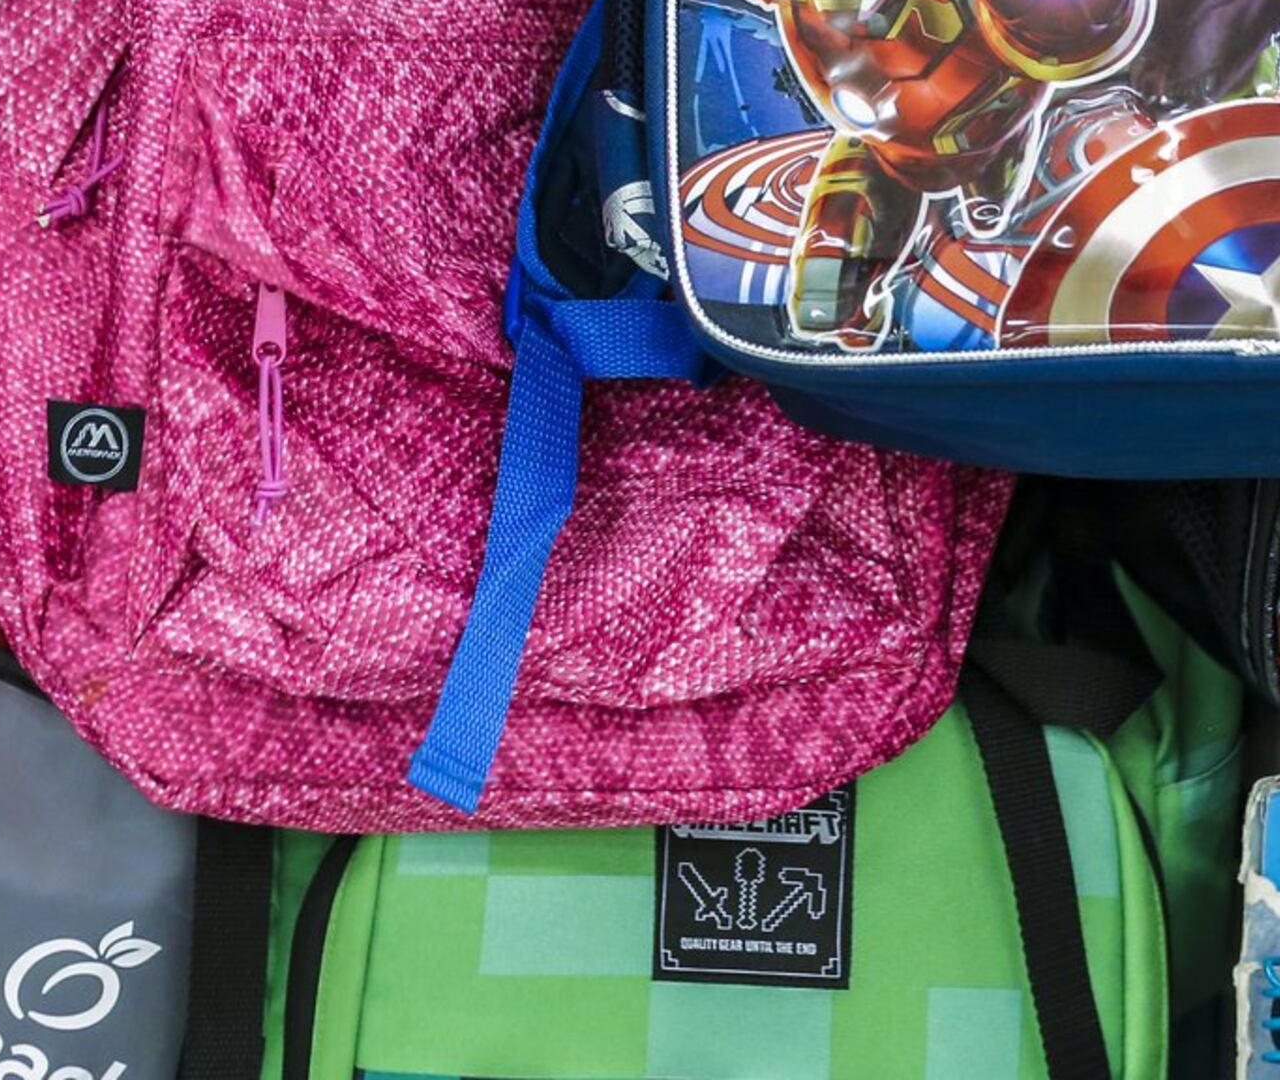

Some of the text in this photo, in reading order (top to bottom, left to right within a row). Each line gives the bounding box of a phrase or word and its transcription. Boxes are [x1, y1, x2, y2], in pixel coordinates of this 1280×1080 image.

[680, 937, 817, 955] QUALITY GEAR UNTIL THE END
